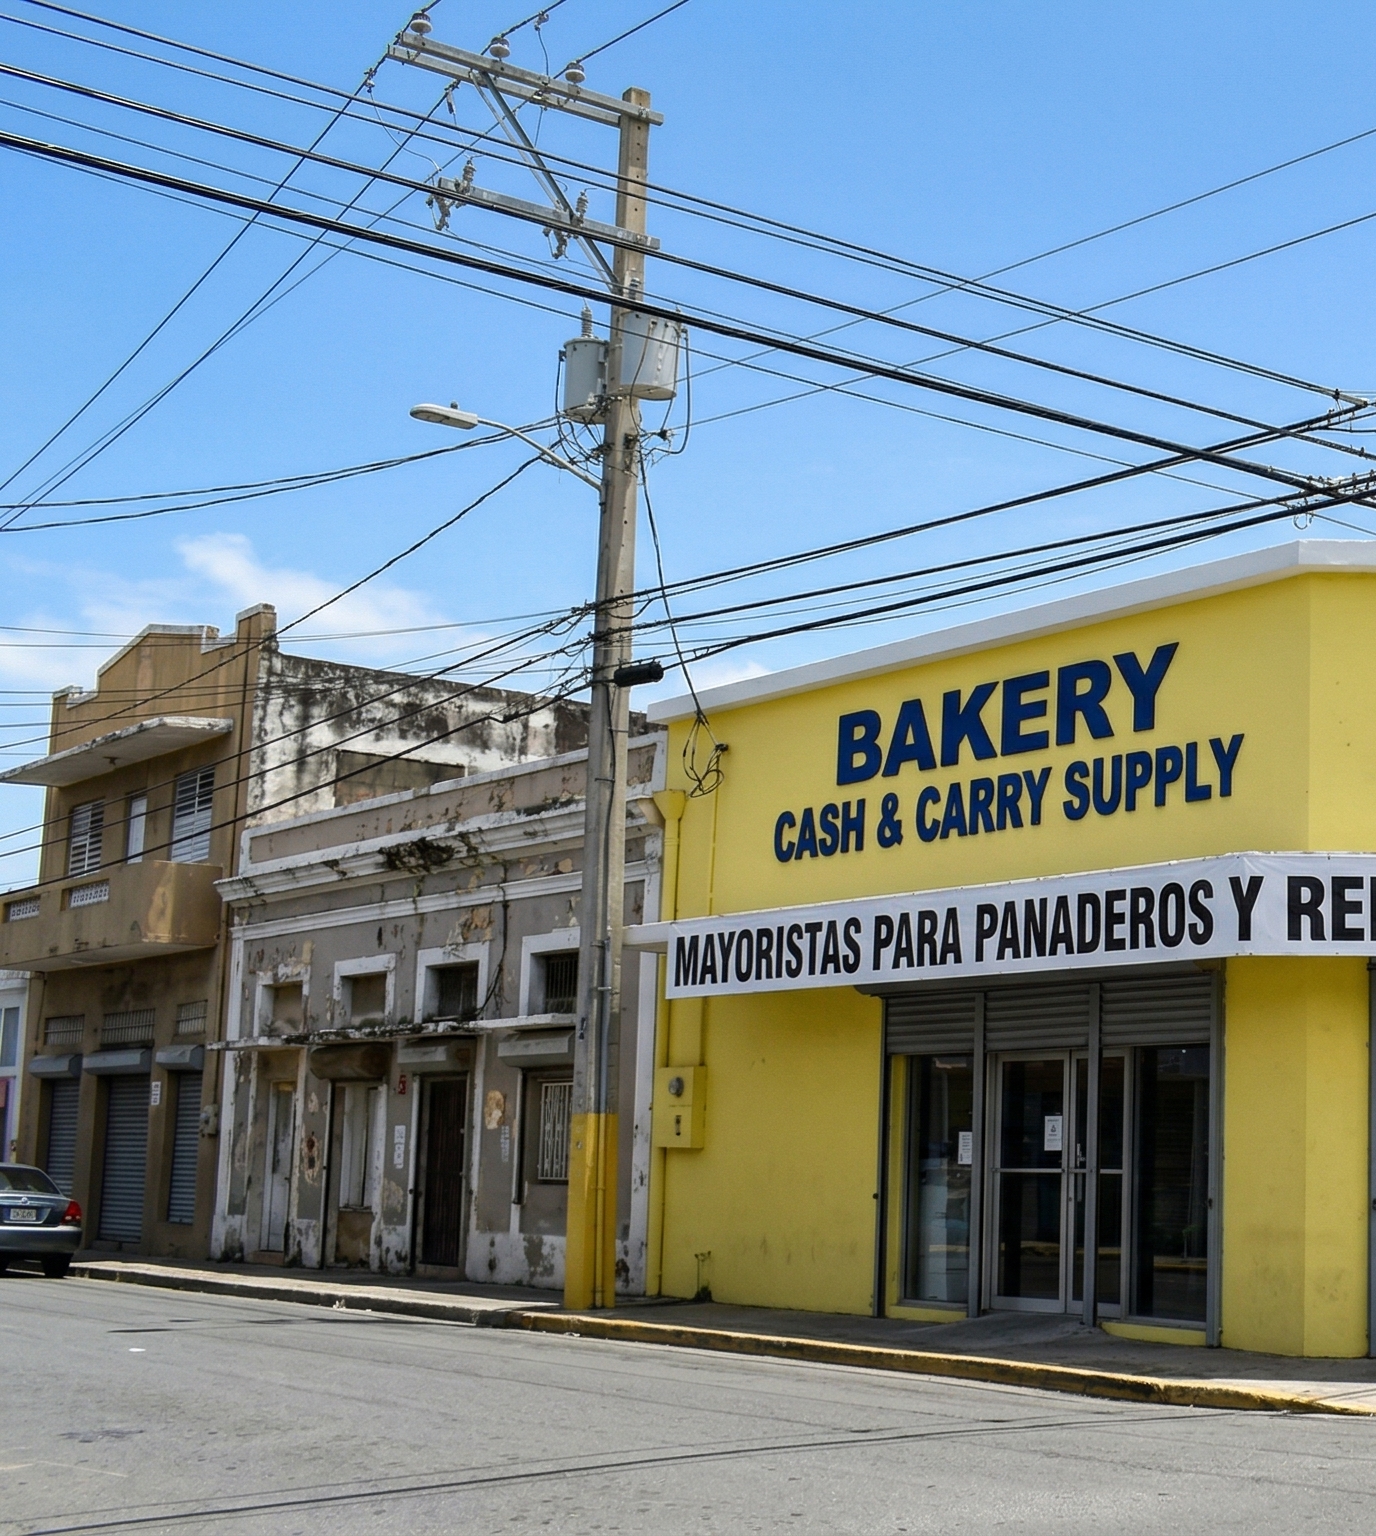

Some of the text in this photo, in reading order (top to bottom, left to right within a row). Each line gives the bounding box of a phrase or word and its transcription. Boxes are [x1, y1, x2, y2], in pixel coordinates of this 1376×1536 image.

[836, 641, 1179, 786] BAKERY
[774, 733, 1244, 862] CASH & CARRY SUPPLY
[674, 916, 861, 987] MAYORISTAS
[872, 906, 962, 971] PARA
[975, 879, 1214, 962] PANADEROS
[1228, 876, 1264, 942] Y
